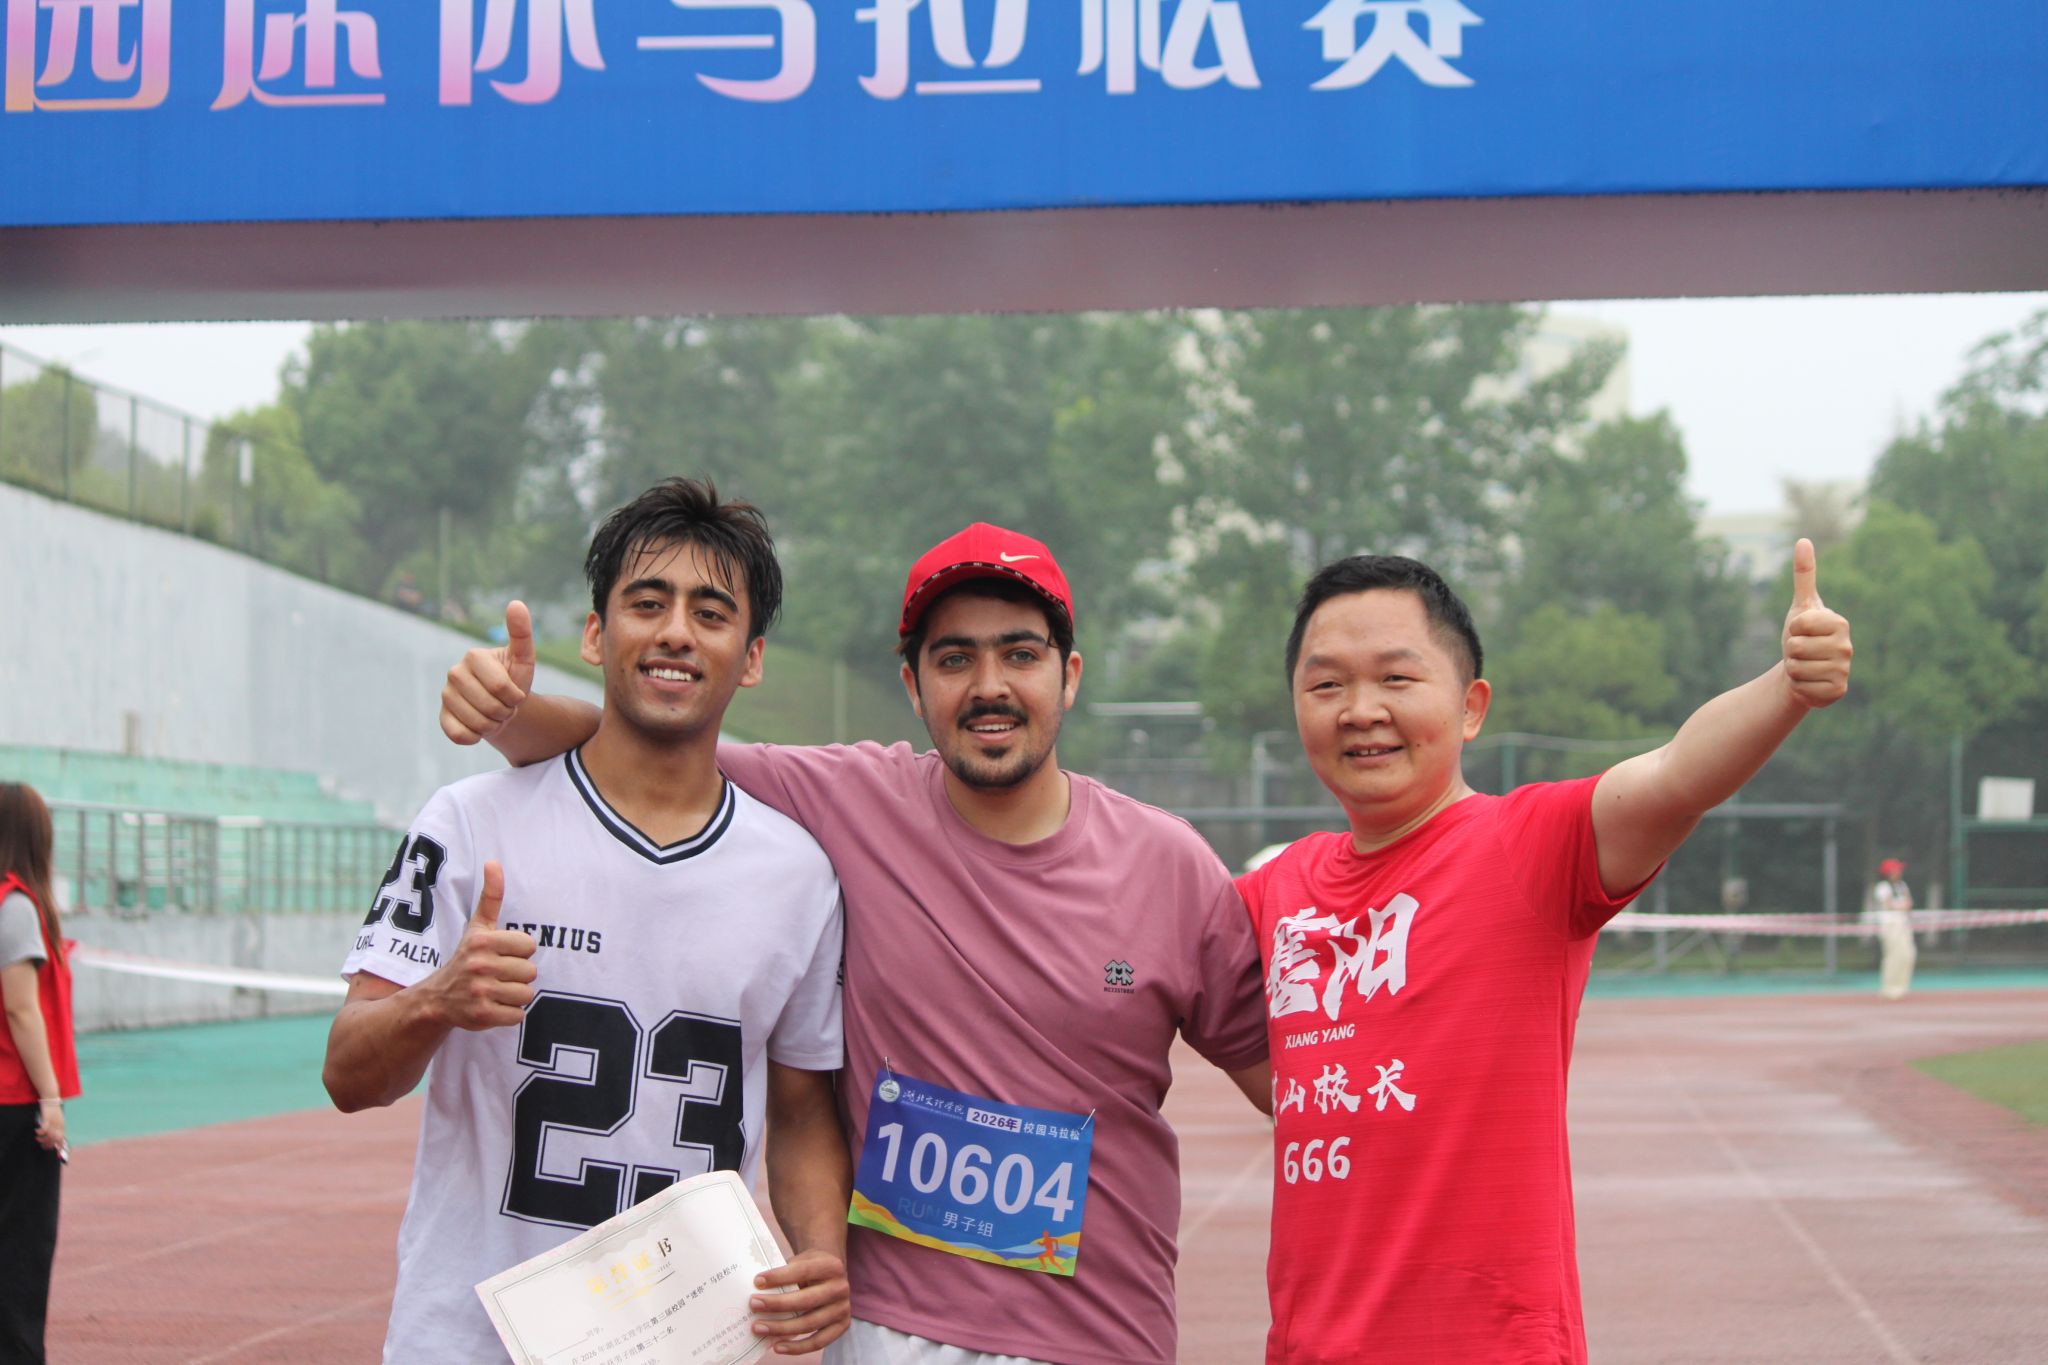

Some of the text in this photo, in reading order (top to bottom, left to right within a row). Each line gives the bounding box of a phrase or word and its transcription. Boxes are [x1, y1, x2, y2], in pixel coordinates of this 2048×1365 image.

[362, 832, 447, 936] 23
[389, 937, 442, 968] TALEN
[1285, 1023, 1356, 1049] XIANG YANG
[500, 989, 748, 1231] 23
[1271, 1058, 1417, 1127] 山校长
[972, 1111, 1080, 1141] 2026年 校园马拉松
[878, 1122, 1075, 1222] 10604
[1283, 1136, 1351, 1184] 666
[942, 1211, 994, 1238] 男子组
